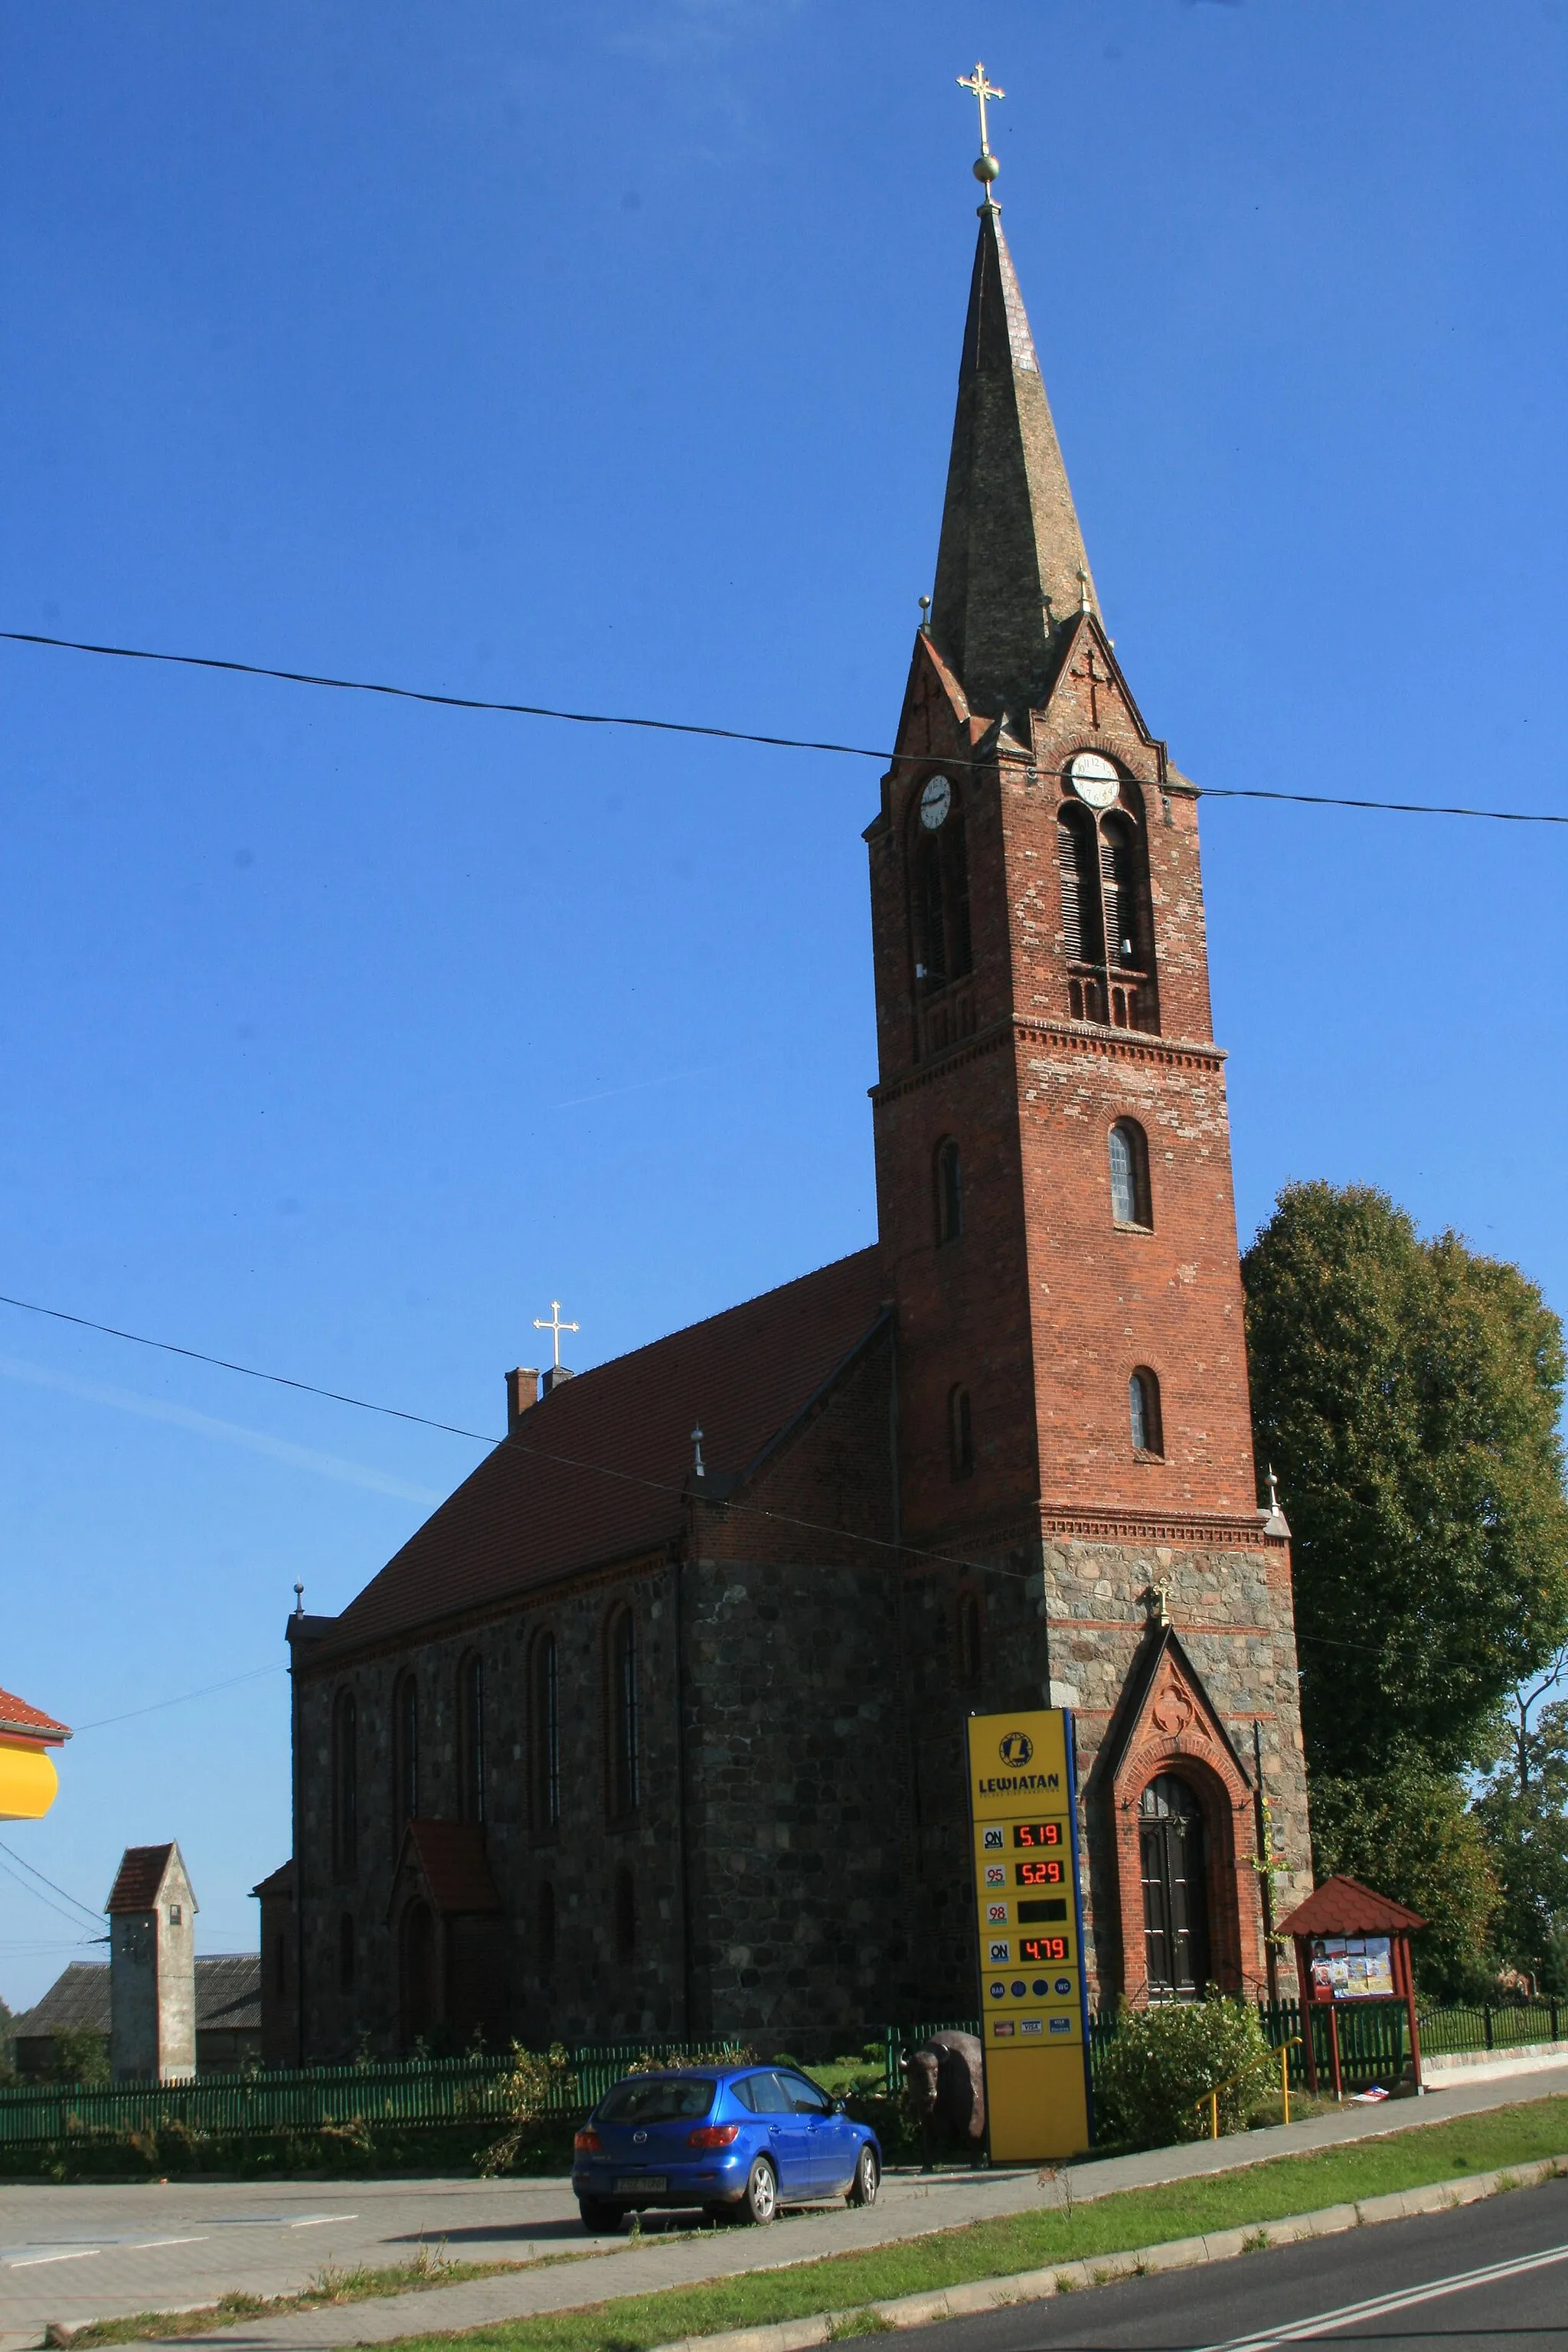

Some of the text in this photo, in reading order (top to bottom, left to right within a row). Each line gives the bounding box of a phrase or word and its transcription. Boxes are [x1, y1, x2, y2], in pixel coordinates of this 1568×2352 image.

[1084, 759, 1089, 768] 11
[1092, 758, 1099, 767] 12
[1093, 793, 1099, 802] 6
[978, 1773, 1059, 1793] LEWIATAN
[985, 1824, 1057, 1846] ON 5.19
[988, 1862, 1060, 1884] 95 5.29
[989, 1906, 1005, 1920] 98
[991, 1939, 1064, 1959] ON 4.79
[991, 1986, 1004, 1994] BAR
